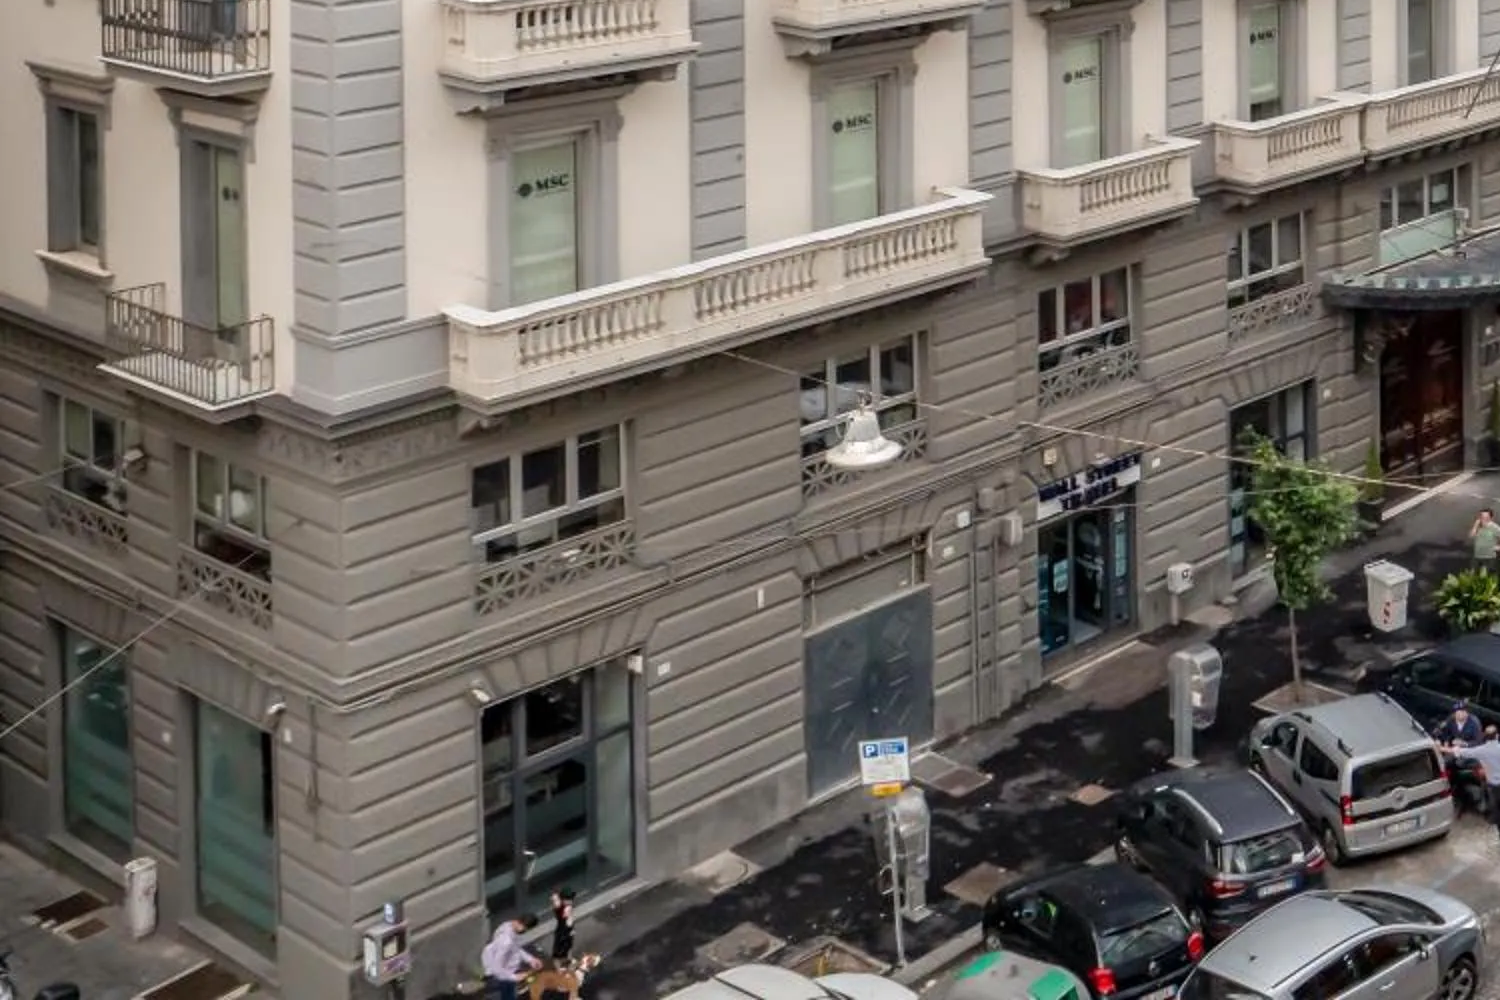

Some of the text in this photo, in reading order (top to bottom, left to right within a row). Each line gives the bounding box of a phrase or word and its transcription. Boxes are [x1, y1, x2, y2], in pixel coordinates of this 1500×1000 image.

[846, 113, 872, 129] MSC
[536, 173, 569, 190] MSC
[865, 745, 875, 757] P
